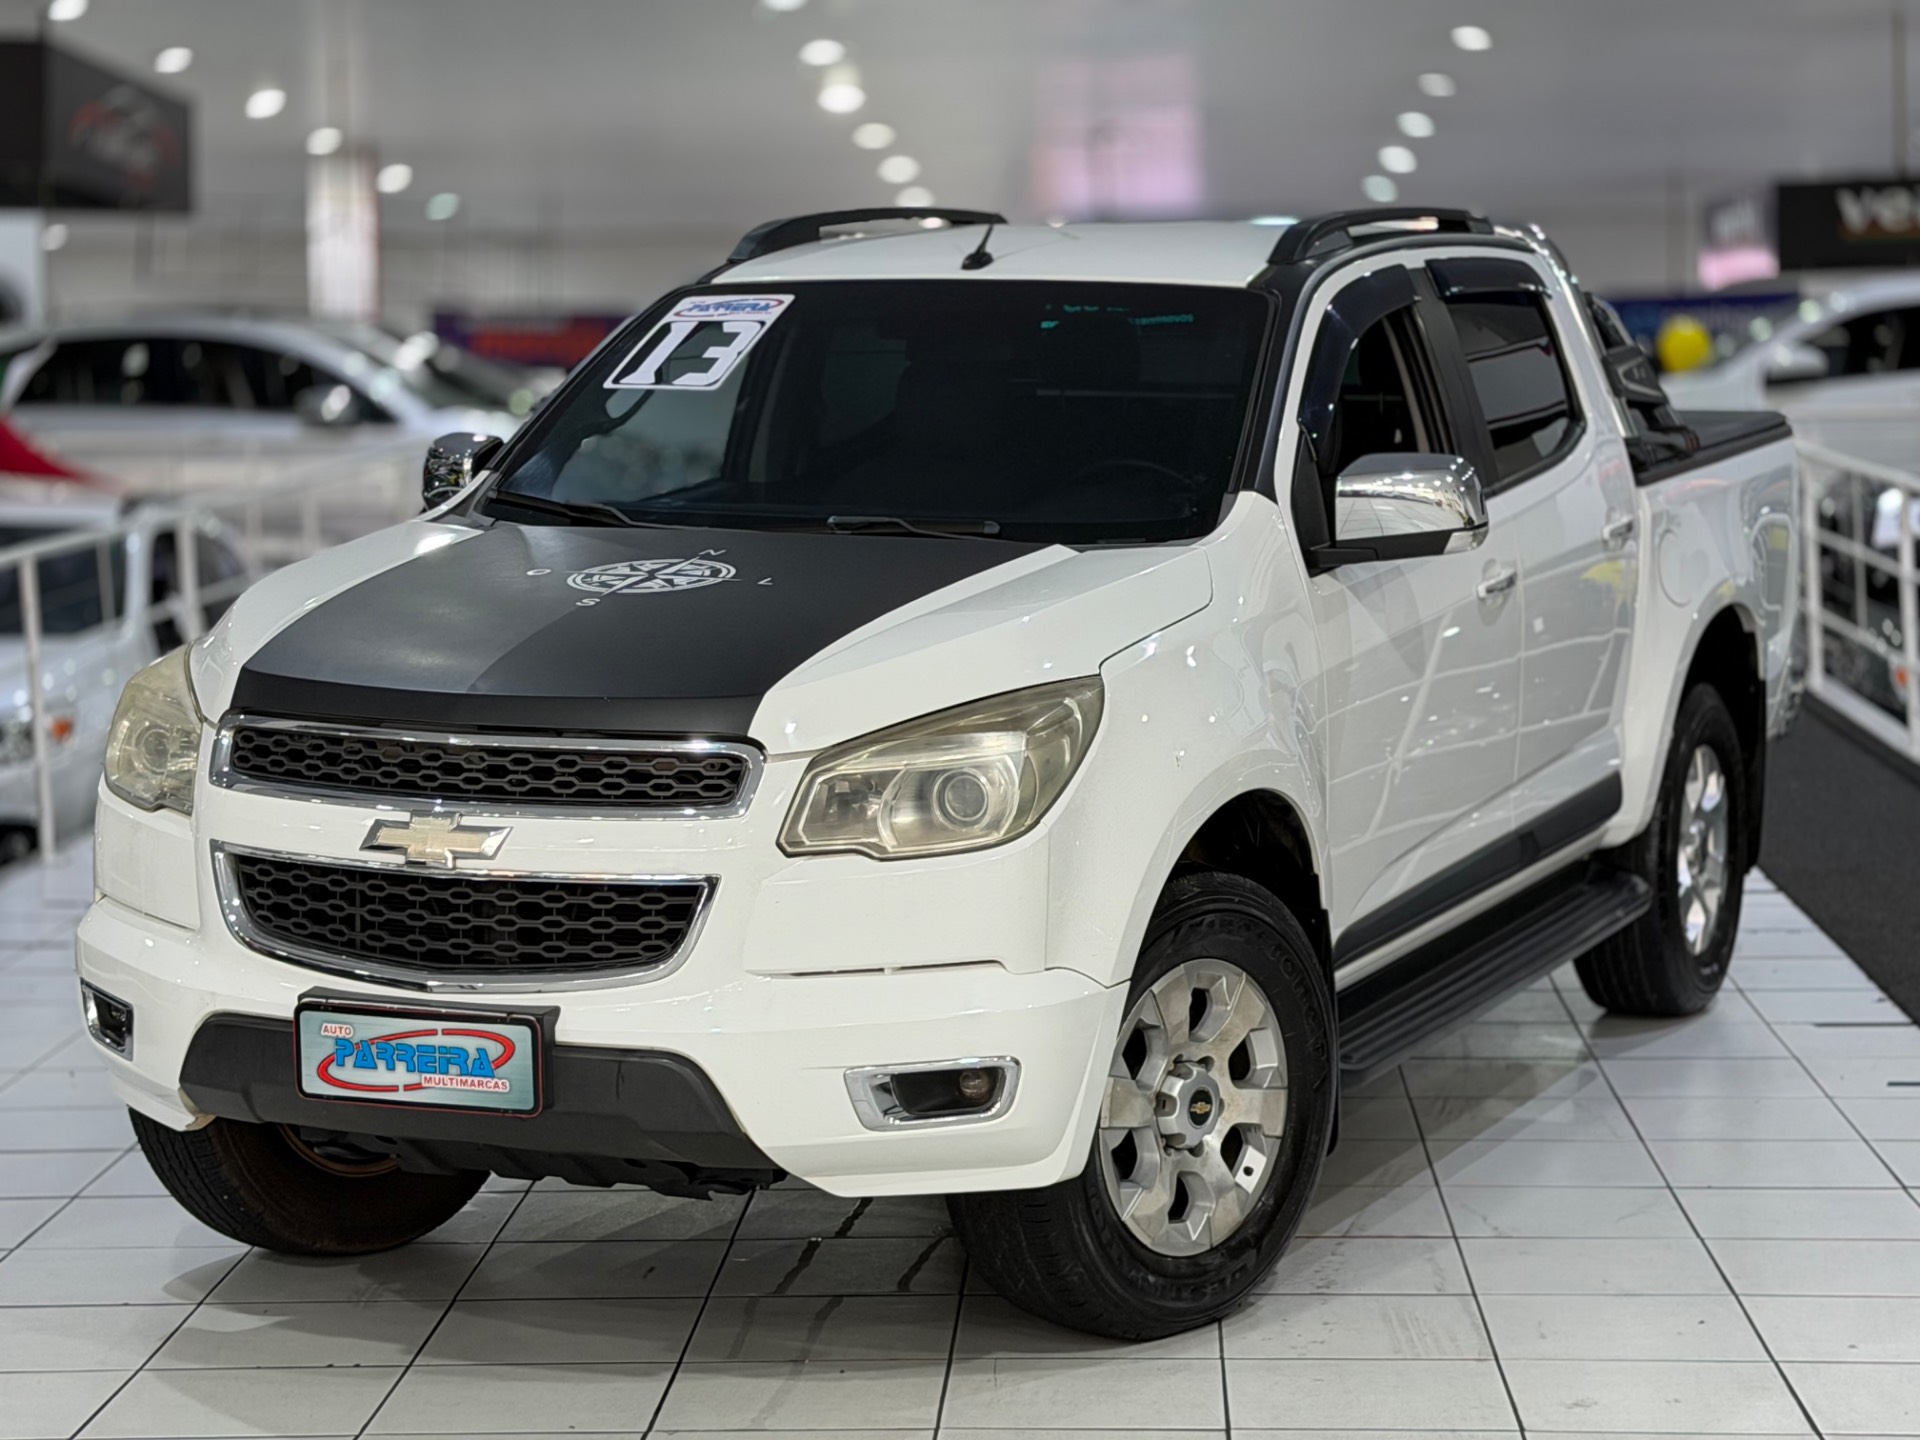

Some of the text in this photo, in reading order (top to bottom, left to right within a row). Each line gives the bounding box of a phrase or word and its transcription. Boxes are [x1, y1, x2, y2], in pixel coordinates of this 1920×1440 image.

[619, 320, 762, 385] 13
[575, 598, 601, 607] S
[321, 1023, 353, 1037] AUTO
[334, 1037, 496, 1078] PARREIRA
[422, 1075, 509, 1091] MULTIMARCAS
